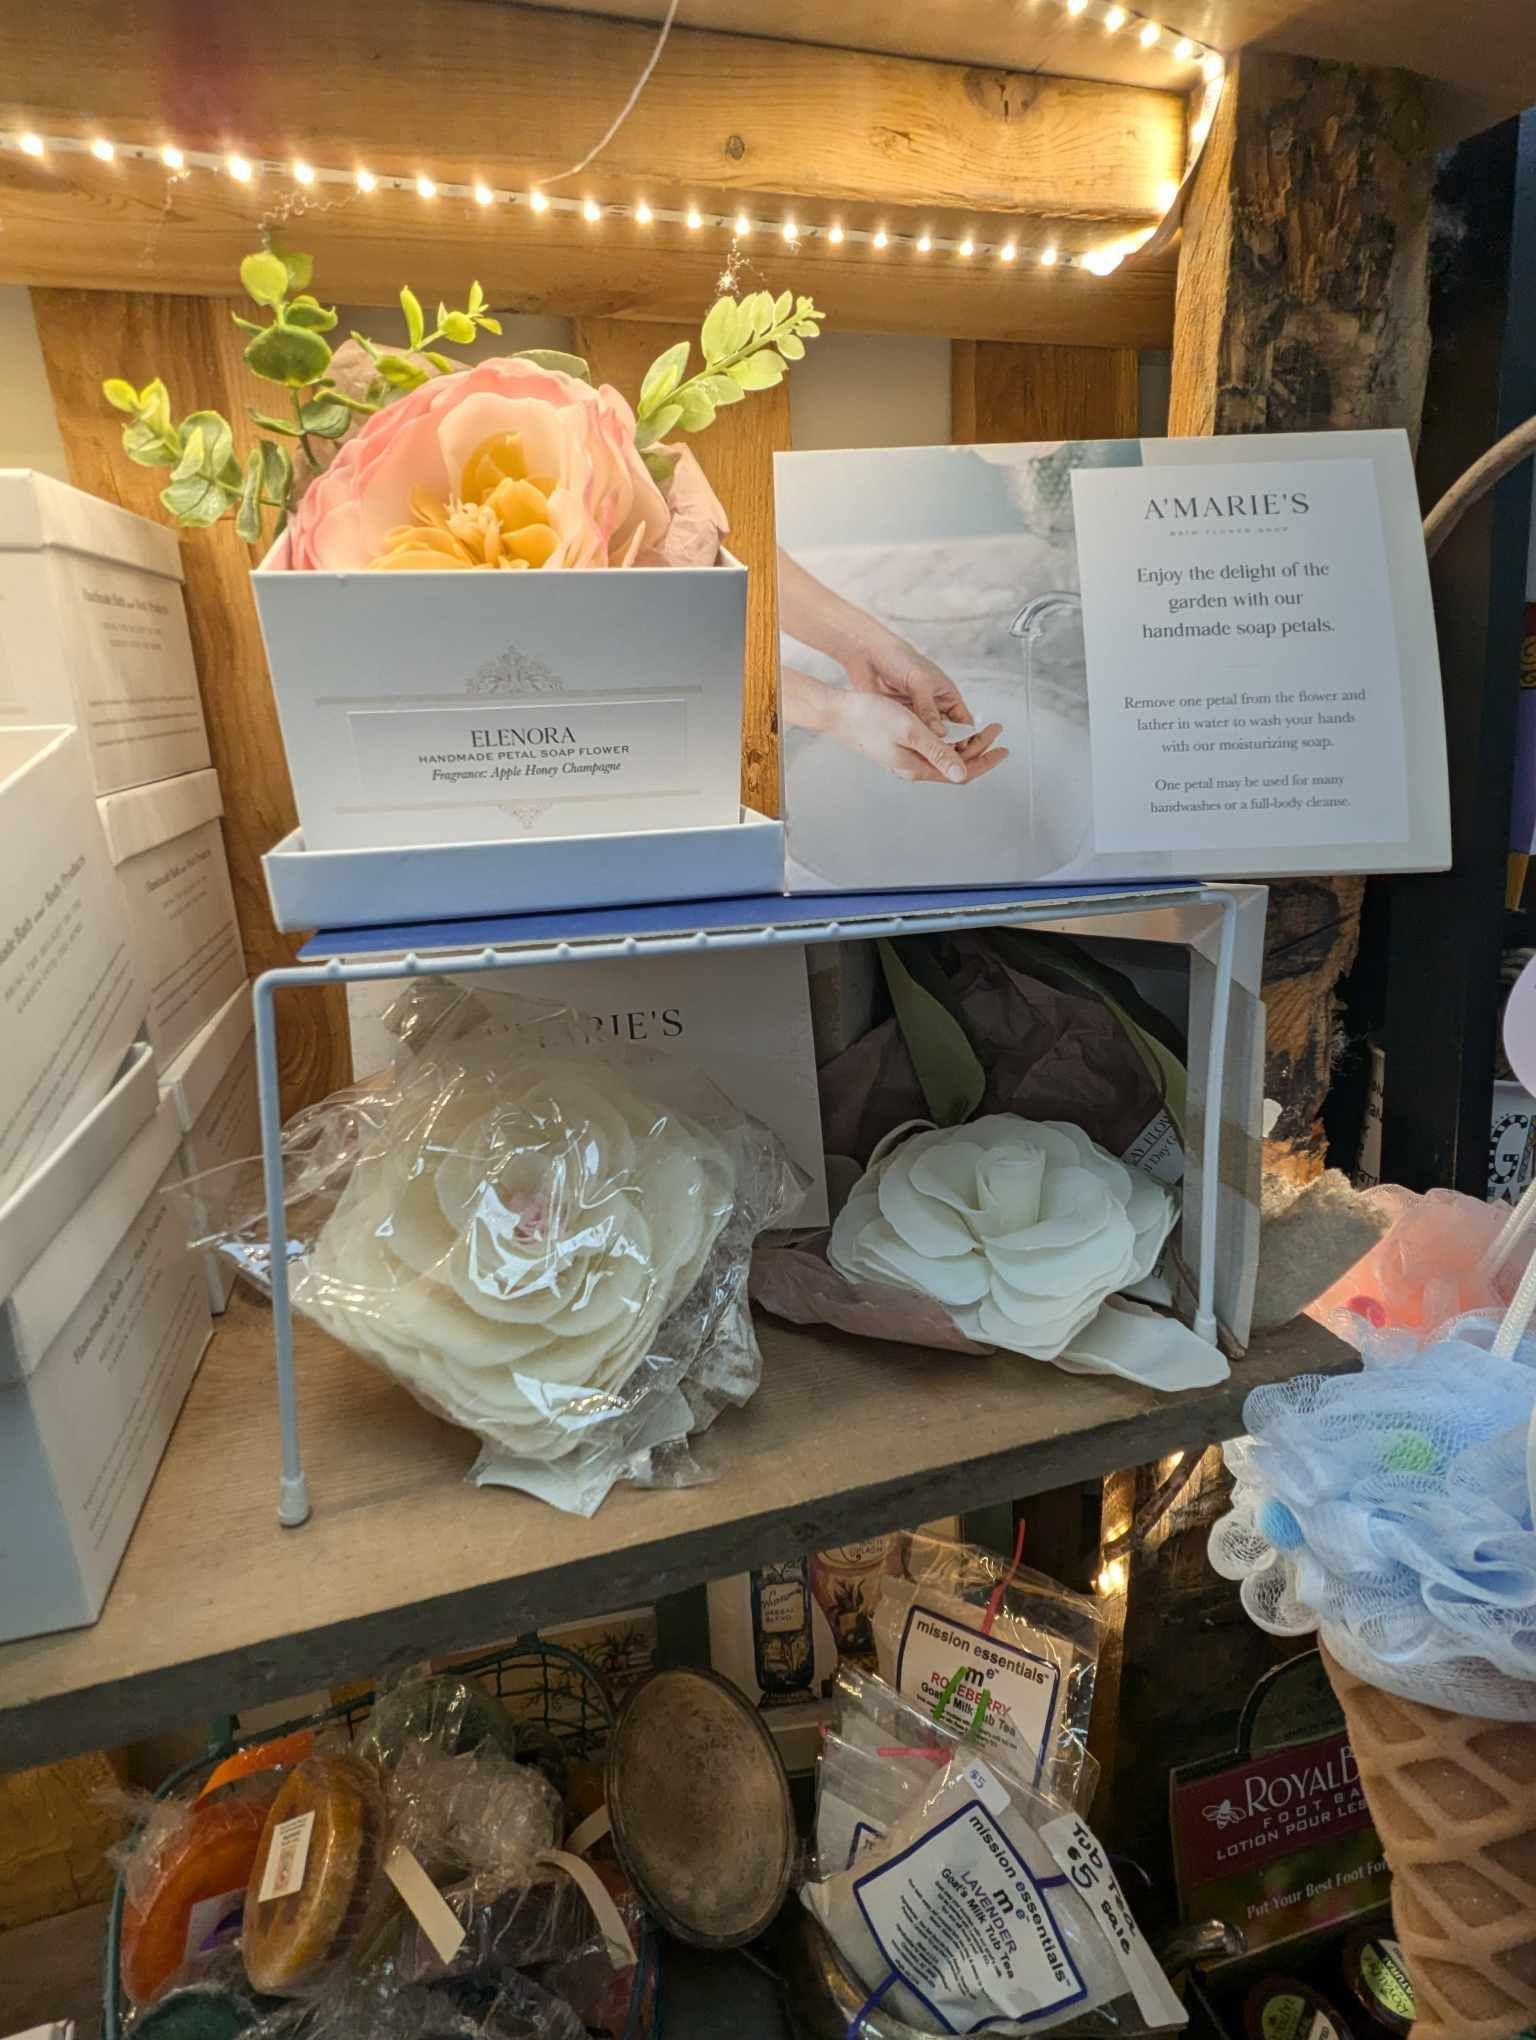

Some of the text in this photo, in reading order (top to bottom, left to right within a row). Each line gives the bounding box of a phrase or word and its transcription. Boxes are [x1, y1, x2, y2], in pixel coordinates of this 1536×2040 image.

[1144, 492, 1310, 520] A'MARIE'S
[1137, 561, 1330, 586] Enjoy the delight of the
[1168, 591, 1305, 614] garden with our
[1143, 617, 1337, 639] handmade soap petals.
[1124, 688, 1367, 710] Remove one petal from the flower and
[1137, 711, 1356, 731] lather in water to wash your hands
[470, 726, 577, 749] ELENORA
[1161, 737, 1335, 753] with our moisturizing soap.
[418, 745, 631, 765] HANDMADE PETAL SOAP FLOWER
[432, 760, 622, 784] Fragrance: Apple Honey Champagne
[1154, 773, 1345, 793] One petal may be used for many
[1150, 800, 1222, 814] handwashes
[1224, 802, 1239, 811] or
[1240, 802, 1248, 810] a
[1250, 797, 1304, 811] full-body
[916, 1620, 971, 1652] mission
[930, 1672, 1012, 1716] ROEBERRY
[953, 1698, 975, 1716] Milk
[999, 1716, 1017, 1738] Tea
[1263, 1800, 1323, 1830] FOOT
[968, 1815, 1018, 1880] mission
[1071, 1821, 1104, 1869] Tub
[1216, 1830, 1279, 1861] LOTION
[1286, 1811, 1332, 1836] POUR
[1247, 1903, 1269, 1919] Put
[1272, 1889, 1303, 1910] Your
[1306, 1877, 1332, 1898] Best
[1336, 1866, 1365, 1884] Foot
[940, 1867, 1016, 1980] Goat's Milk Tub Tea
[960, 1870, 1018, 1954] LAVENDER
